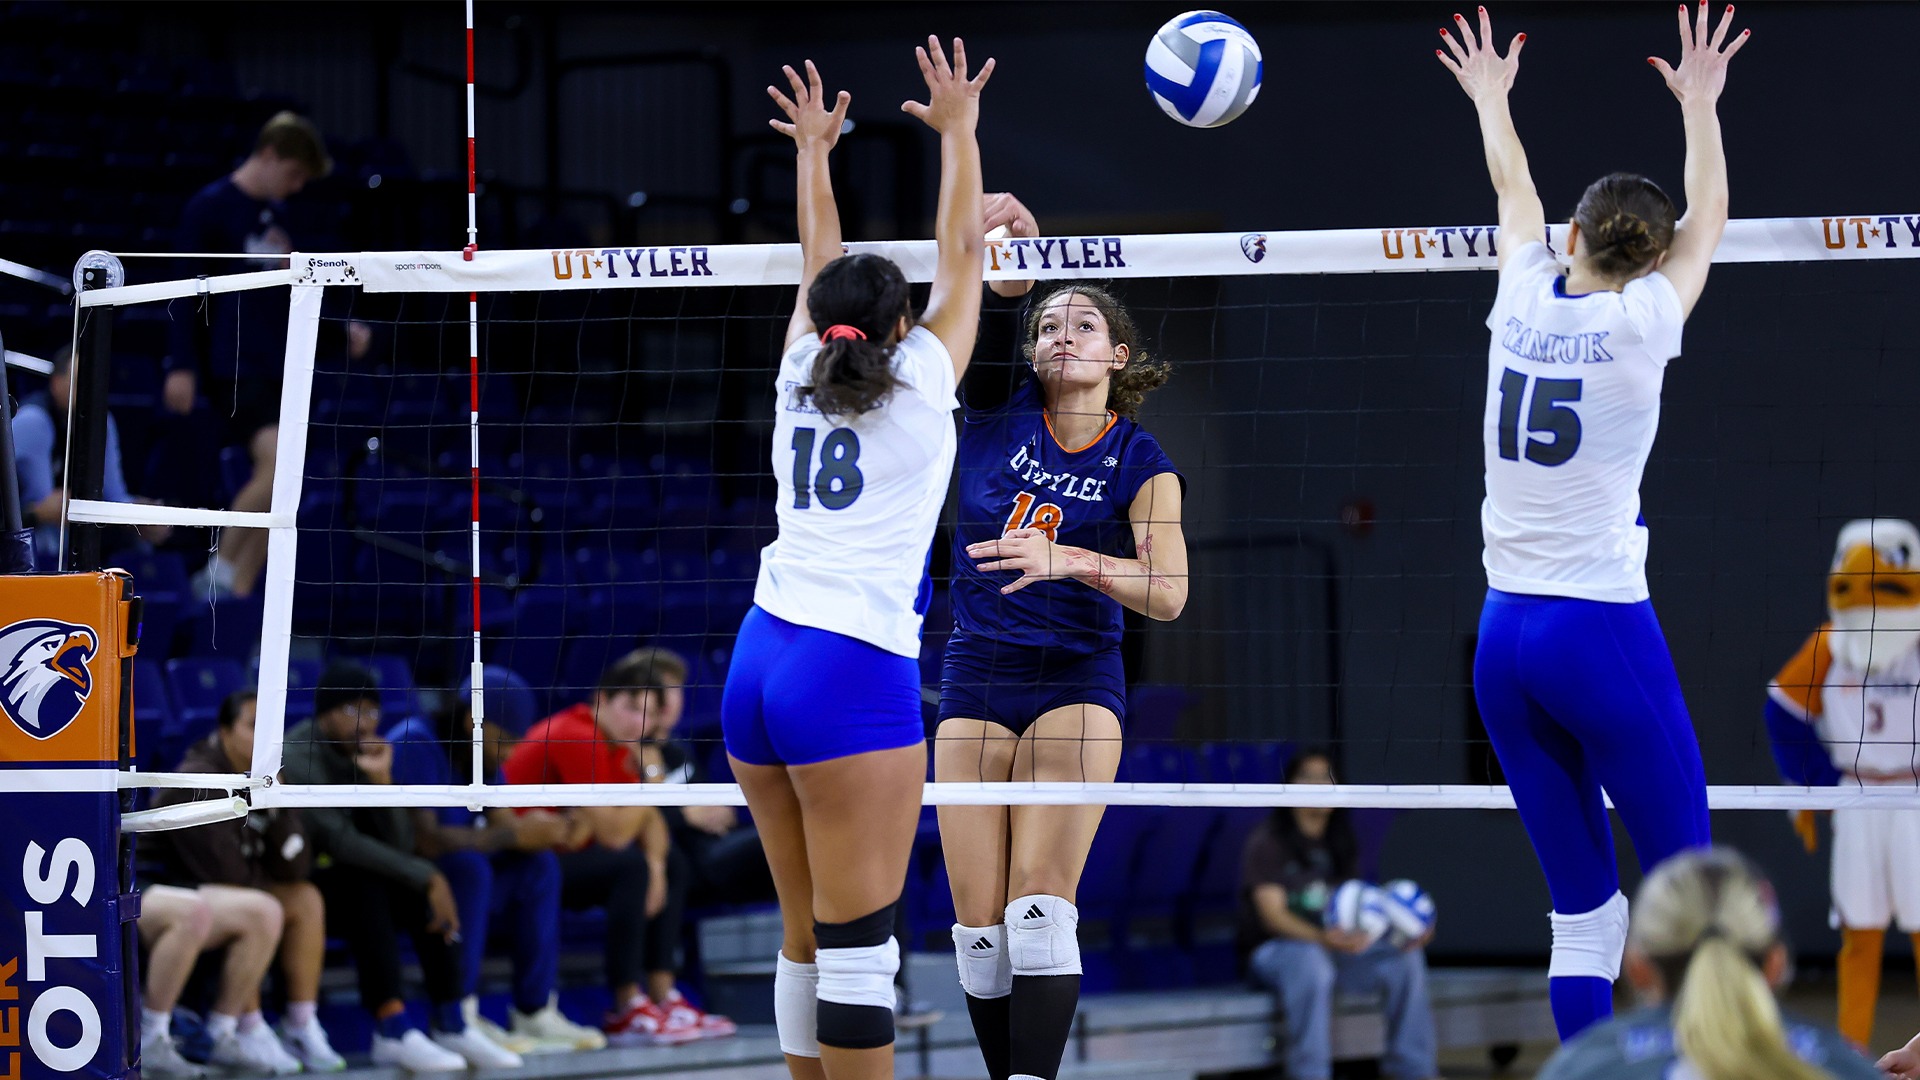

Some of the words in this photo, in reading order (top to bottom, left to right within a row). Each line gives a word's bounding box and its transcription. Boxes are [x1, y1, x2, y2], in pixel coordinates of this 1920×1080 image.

[316, 259, 348, 268] Senoh
[395, 263, 416, 271] sports
[601, 247, 713, 279] TYLER
[1010, 237, 1126, 270] TYLER
[1502, 316, 1614, 364] TAMUK
[1498, 366, 1583, 468] 15
[791, 426, 864, 511] 18
[1001, 490, 1063, 544] 18
[22, 837, 102, 1073] OTS
